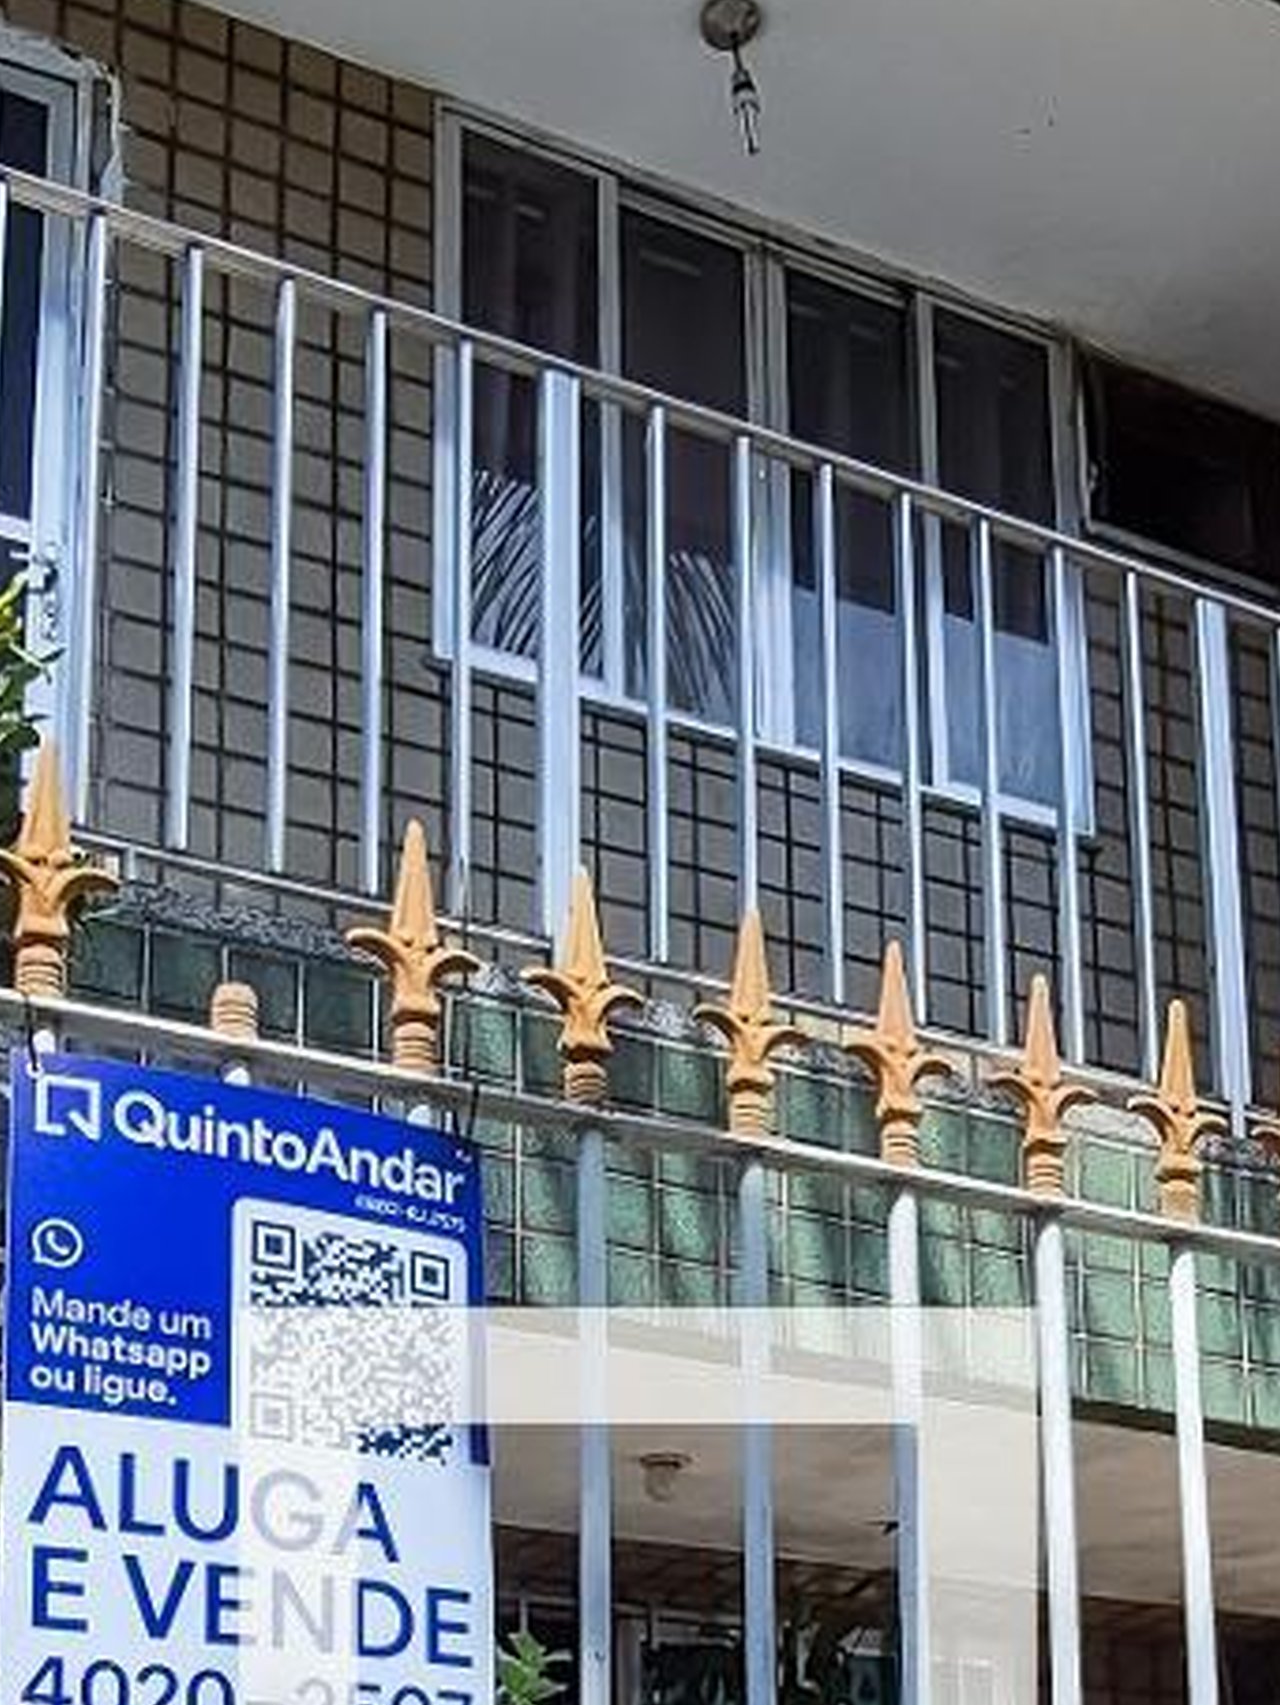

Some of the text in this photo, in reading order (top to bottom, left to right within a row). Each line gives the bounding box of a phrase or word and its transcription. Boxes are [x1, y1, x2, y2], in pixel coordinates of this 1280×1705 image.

[113, 1090, 466, 1204] QuintoAndar
[31, 1286, 212, 1340] Mande um
[31, 1322, 211, 1381] Whatsapp
[29, 1362, 176, 1406] ou ligue.
[27, 1445, 400, 1563] ALUGA
[31, 1545, 474, 1669] E VENDE
